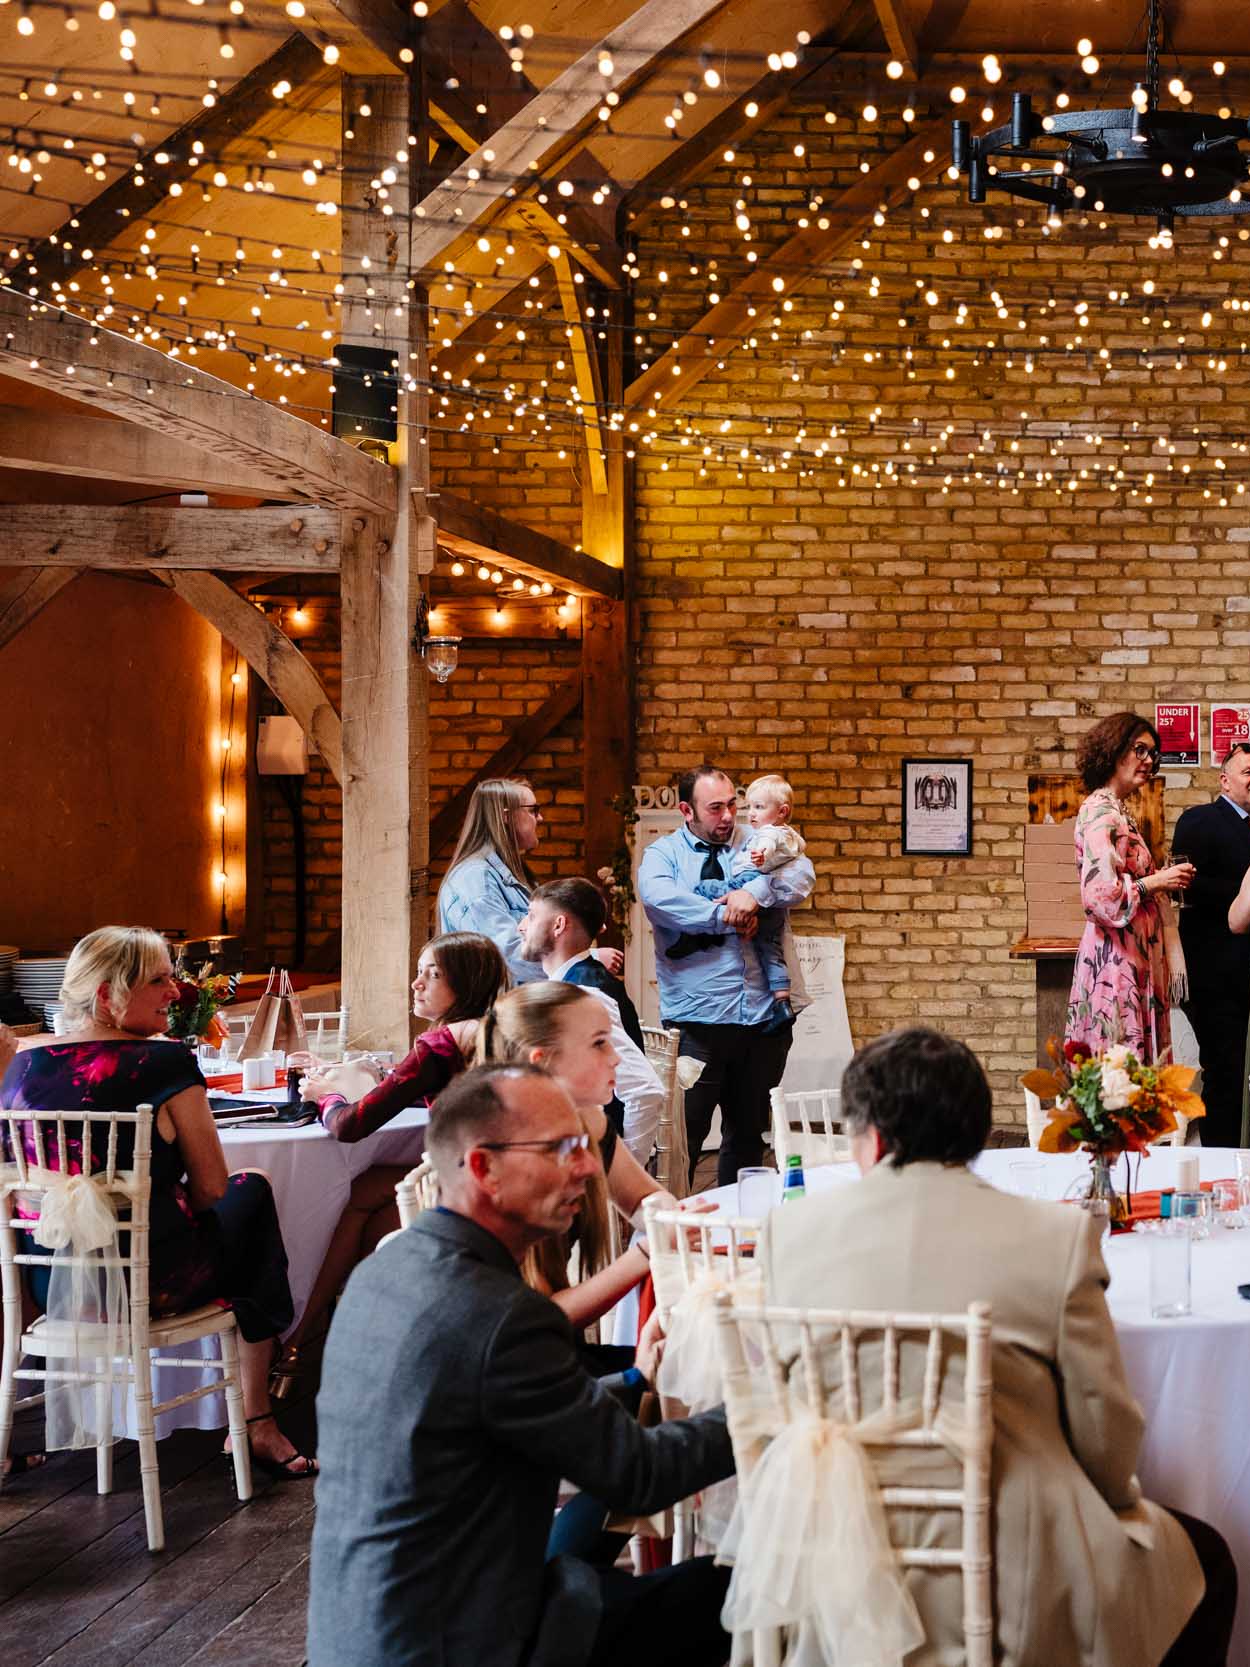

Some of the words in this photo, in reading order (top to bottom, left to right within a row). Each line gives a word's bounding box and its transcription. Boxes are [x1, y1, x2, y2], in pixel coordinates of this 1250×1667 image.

[1159, 708, 1189, 716] UNDER
[1237, 711, 1250, 720] 25
[1159, 718, 1174, 726] 25?
[1234, 725, 1249, 735] 18
